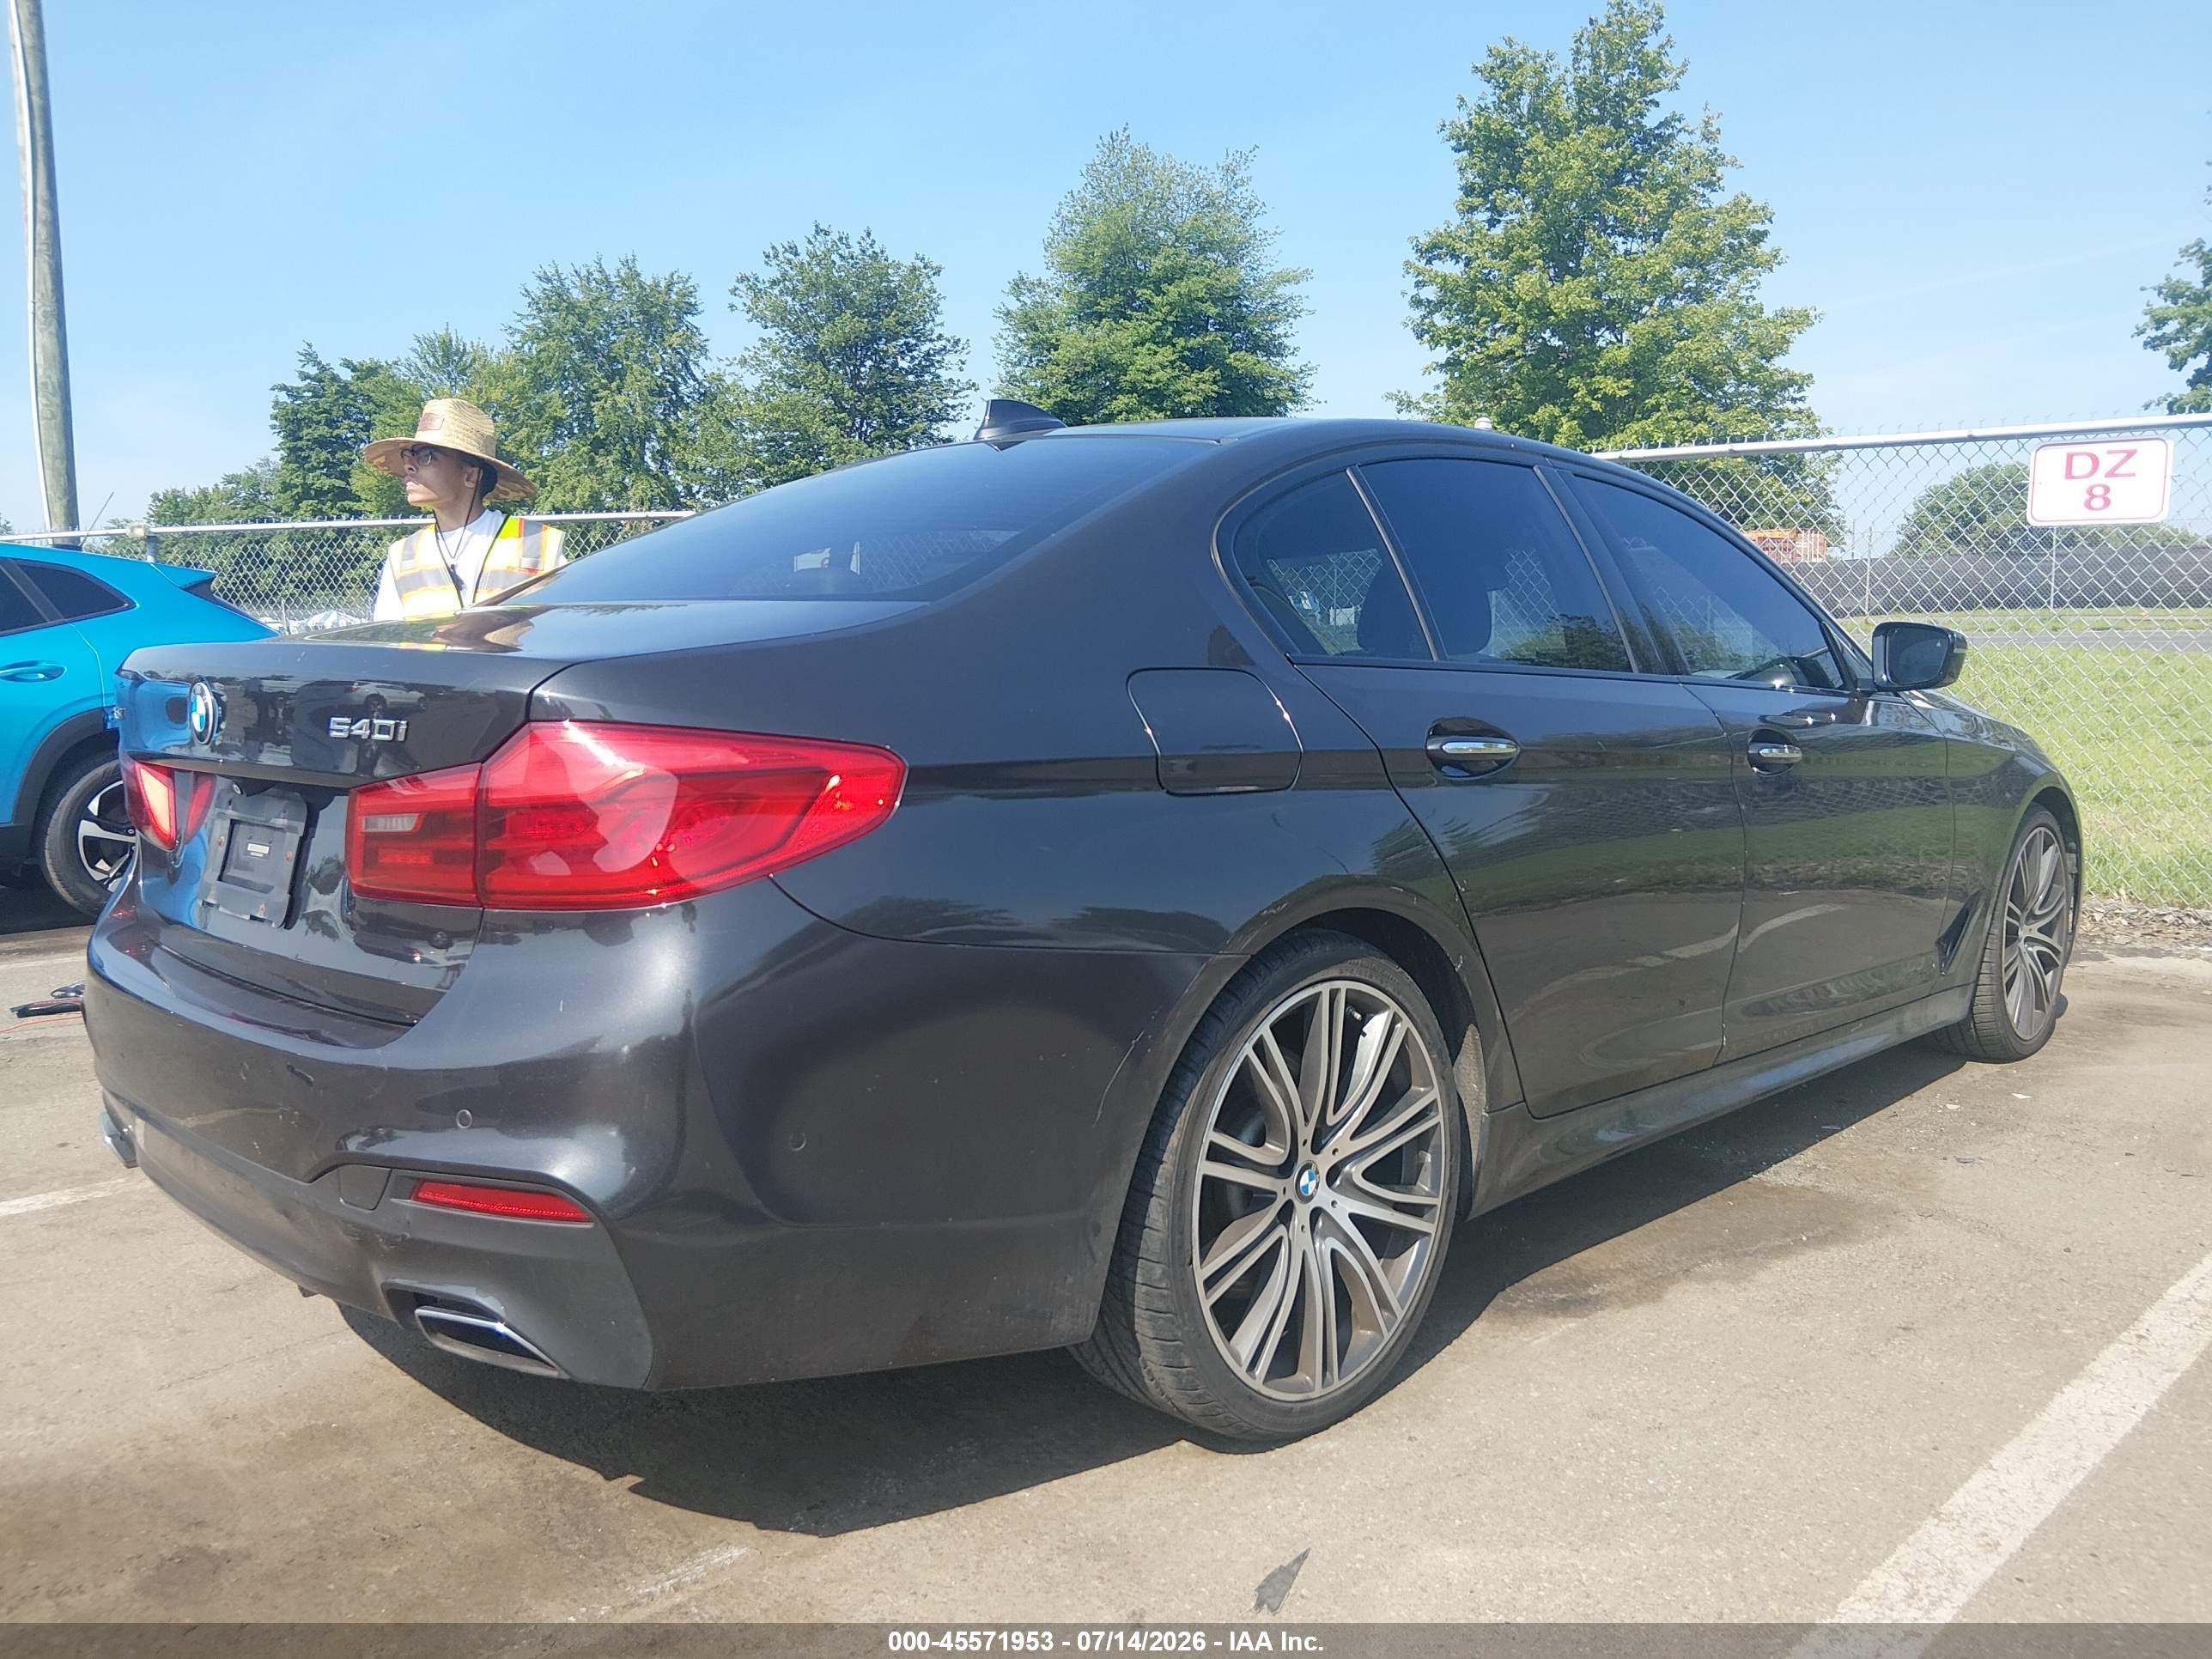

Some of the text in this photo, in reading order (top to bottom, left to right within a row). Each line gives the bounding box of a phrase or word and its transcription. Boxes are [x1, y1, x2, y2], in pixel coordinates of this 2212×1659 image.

[2064, 448, 2137, 480] DZ
[2083, 483, 2111, 511] 8
[329, 716, 407, 742] 540i
